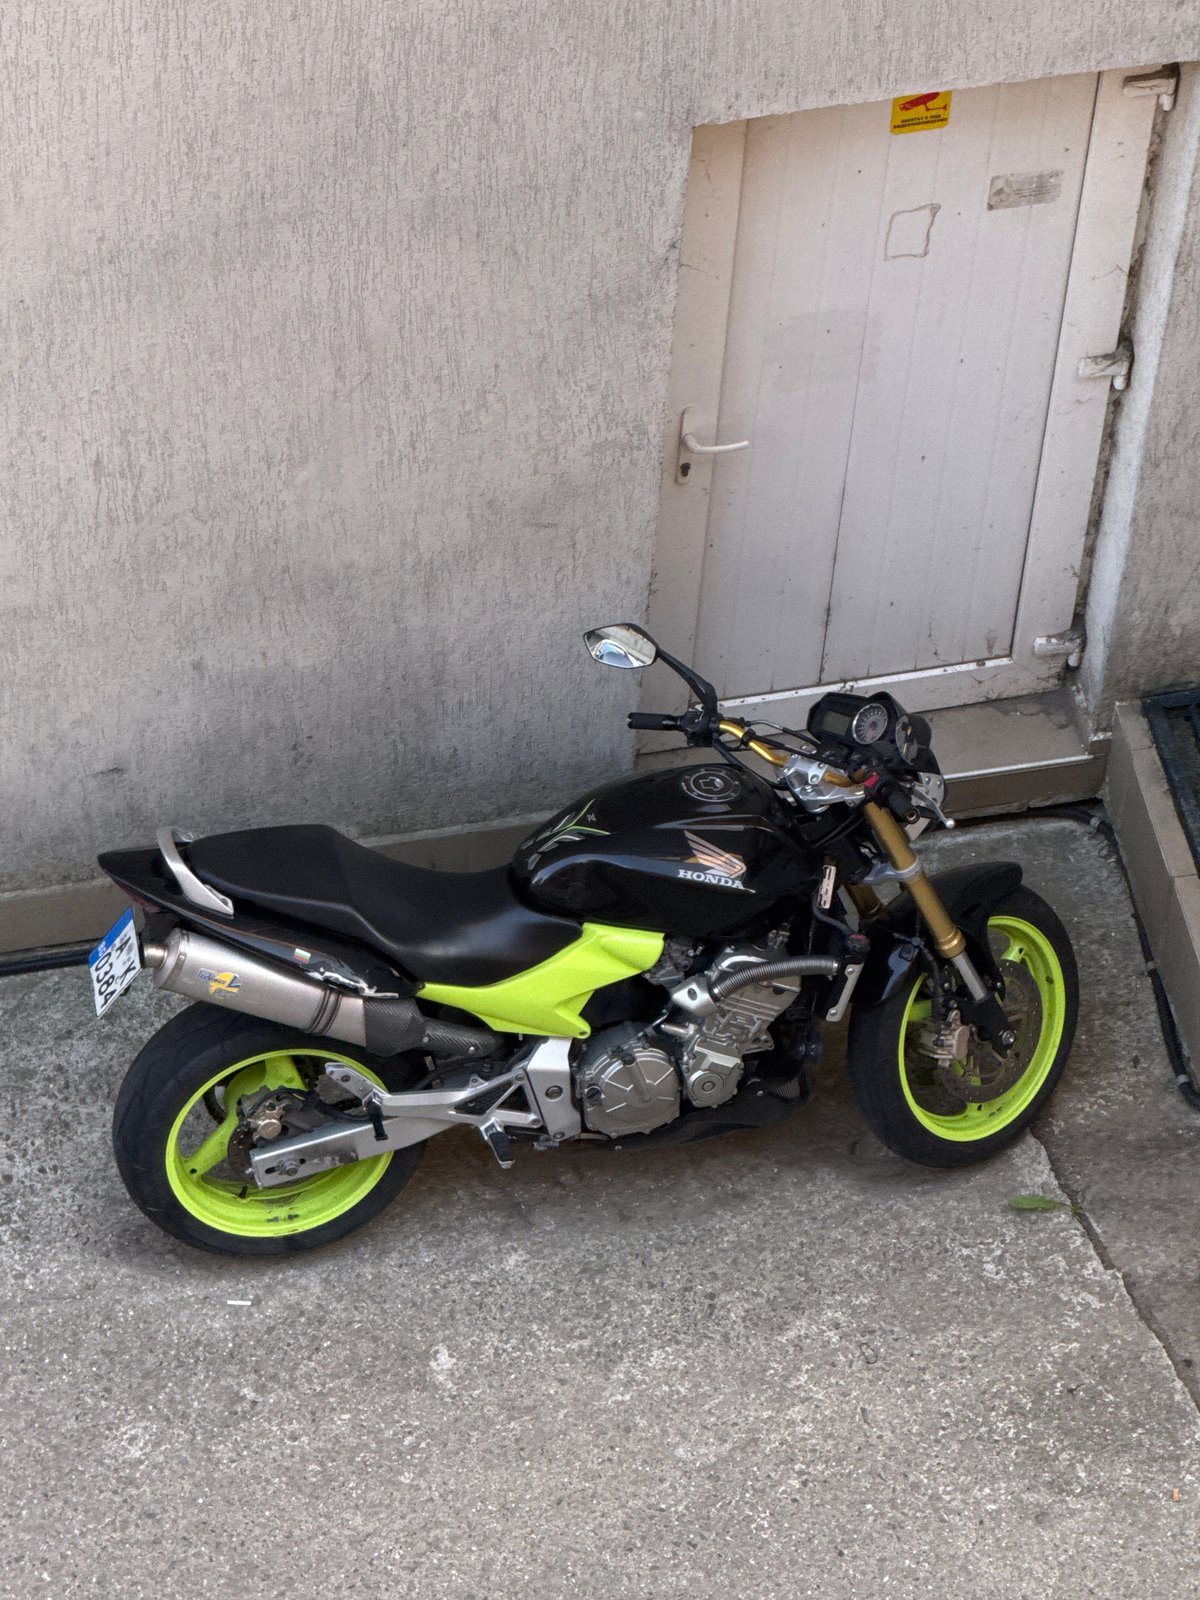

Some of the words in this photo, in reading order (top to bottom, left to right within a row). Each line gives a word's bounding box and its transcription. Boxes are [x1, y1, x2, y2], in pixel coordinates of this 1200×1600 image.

[678, 869, 744, 889] HONDA
[115, 936, 131, 959] A
[94, 952, 117, 1008] 0384
[119, 960, 136, 985] K
